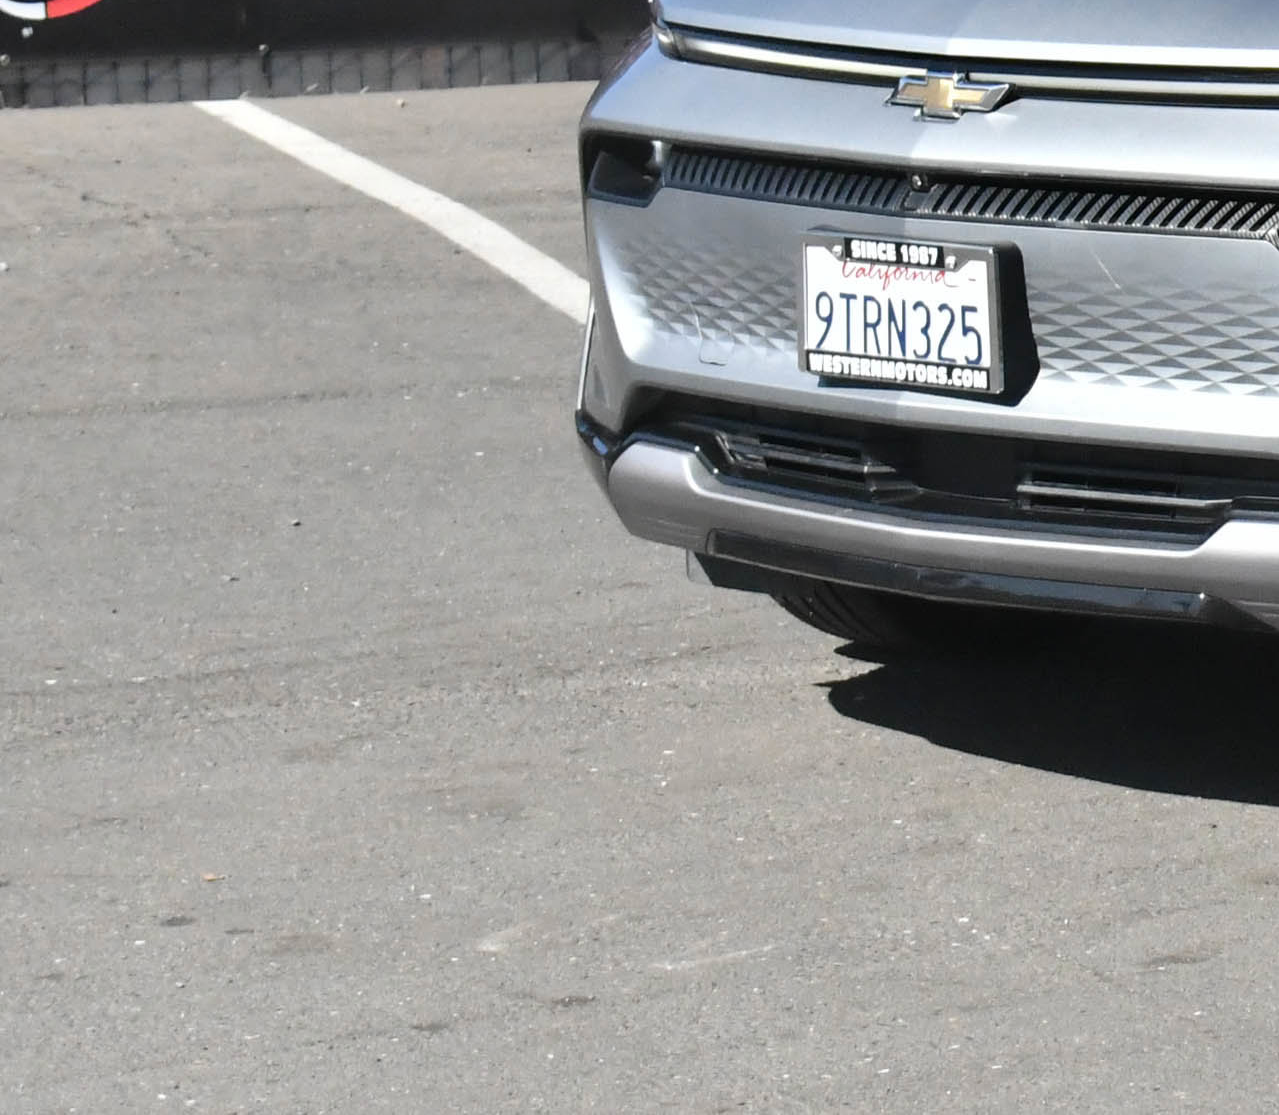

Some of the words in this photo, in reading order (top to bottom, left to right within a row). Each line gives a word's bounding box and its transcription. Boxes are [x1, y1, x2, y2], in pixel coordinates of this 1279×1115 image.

[851, 239, 896, 262] SINCE
[900, 244, 938, 266] 1987
[842, 260, 948, 291] California
[816, 291, 982, 365] 9TRN325
[809, 353, 988, 389] WESTERNMOTORS.COM
